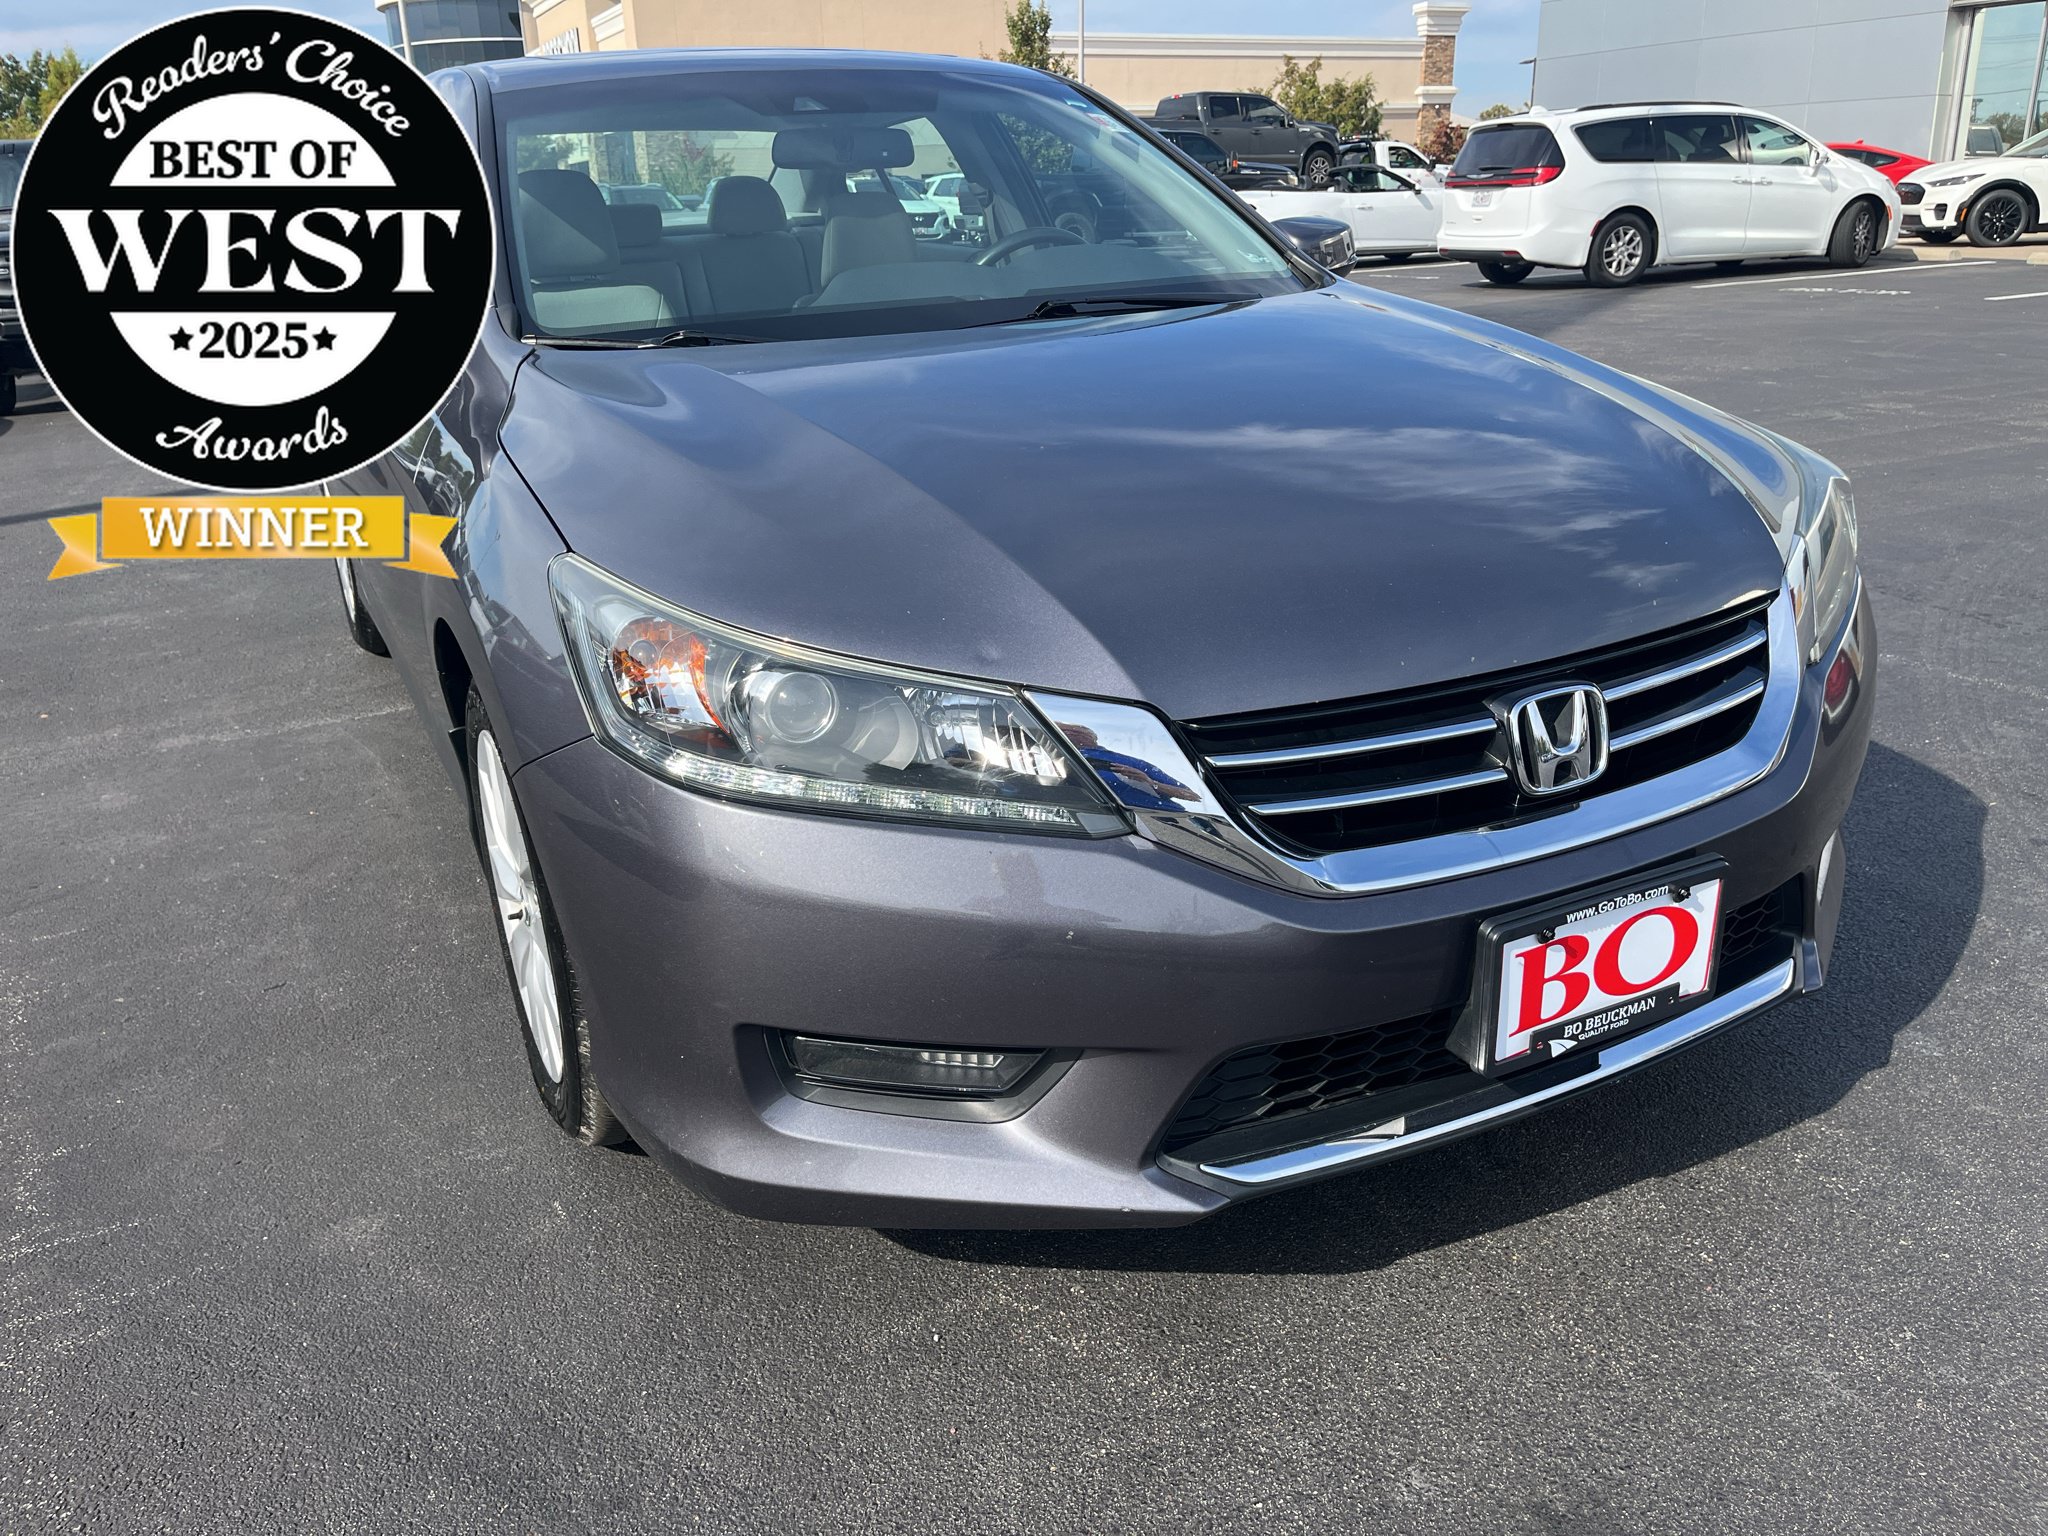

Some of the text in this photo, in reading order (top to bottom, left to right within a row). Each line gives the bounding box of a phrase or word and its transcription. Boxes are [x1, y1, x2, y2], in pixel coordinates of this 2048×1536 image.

[1565, 885, 1669, 924] www.GoToBo.com
[1508, 905, 1699, 1038] BO
[1563, 996, 1656, 1038] BO BEUCKMAN
[1578, 1018, 1630, 1040] QUALITY FORD
